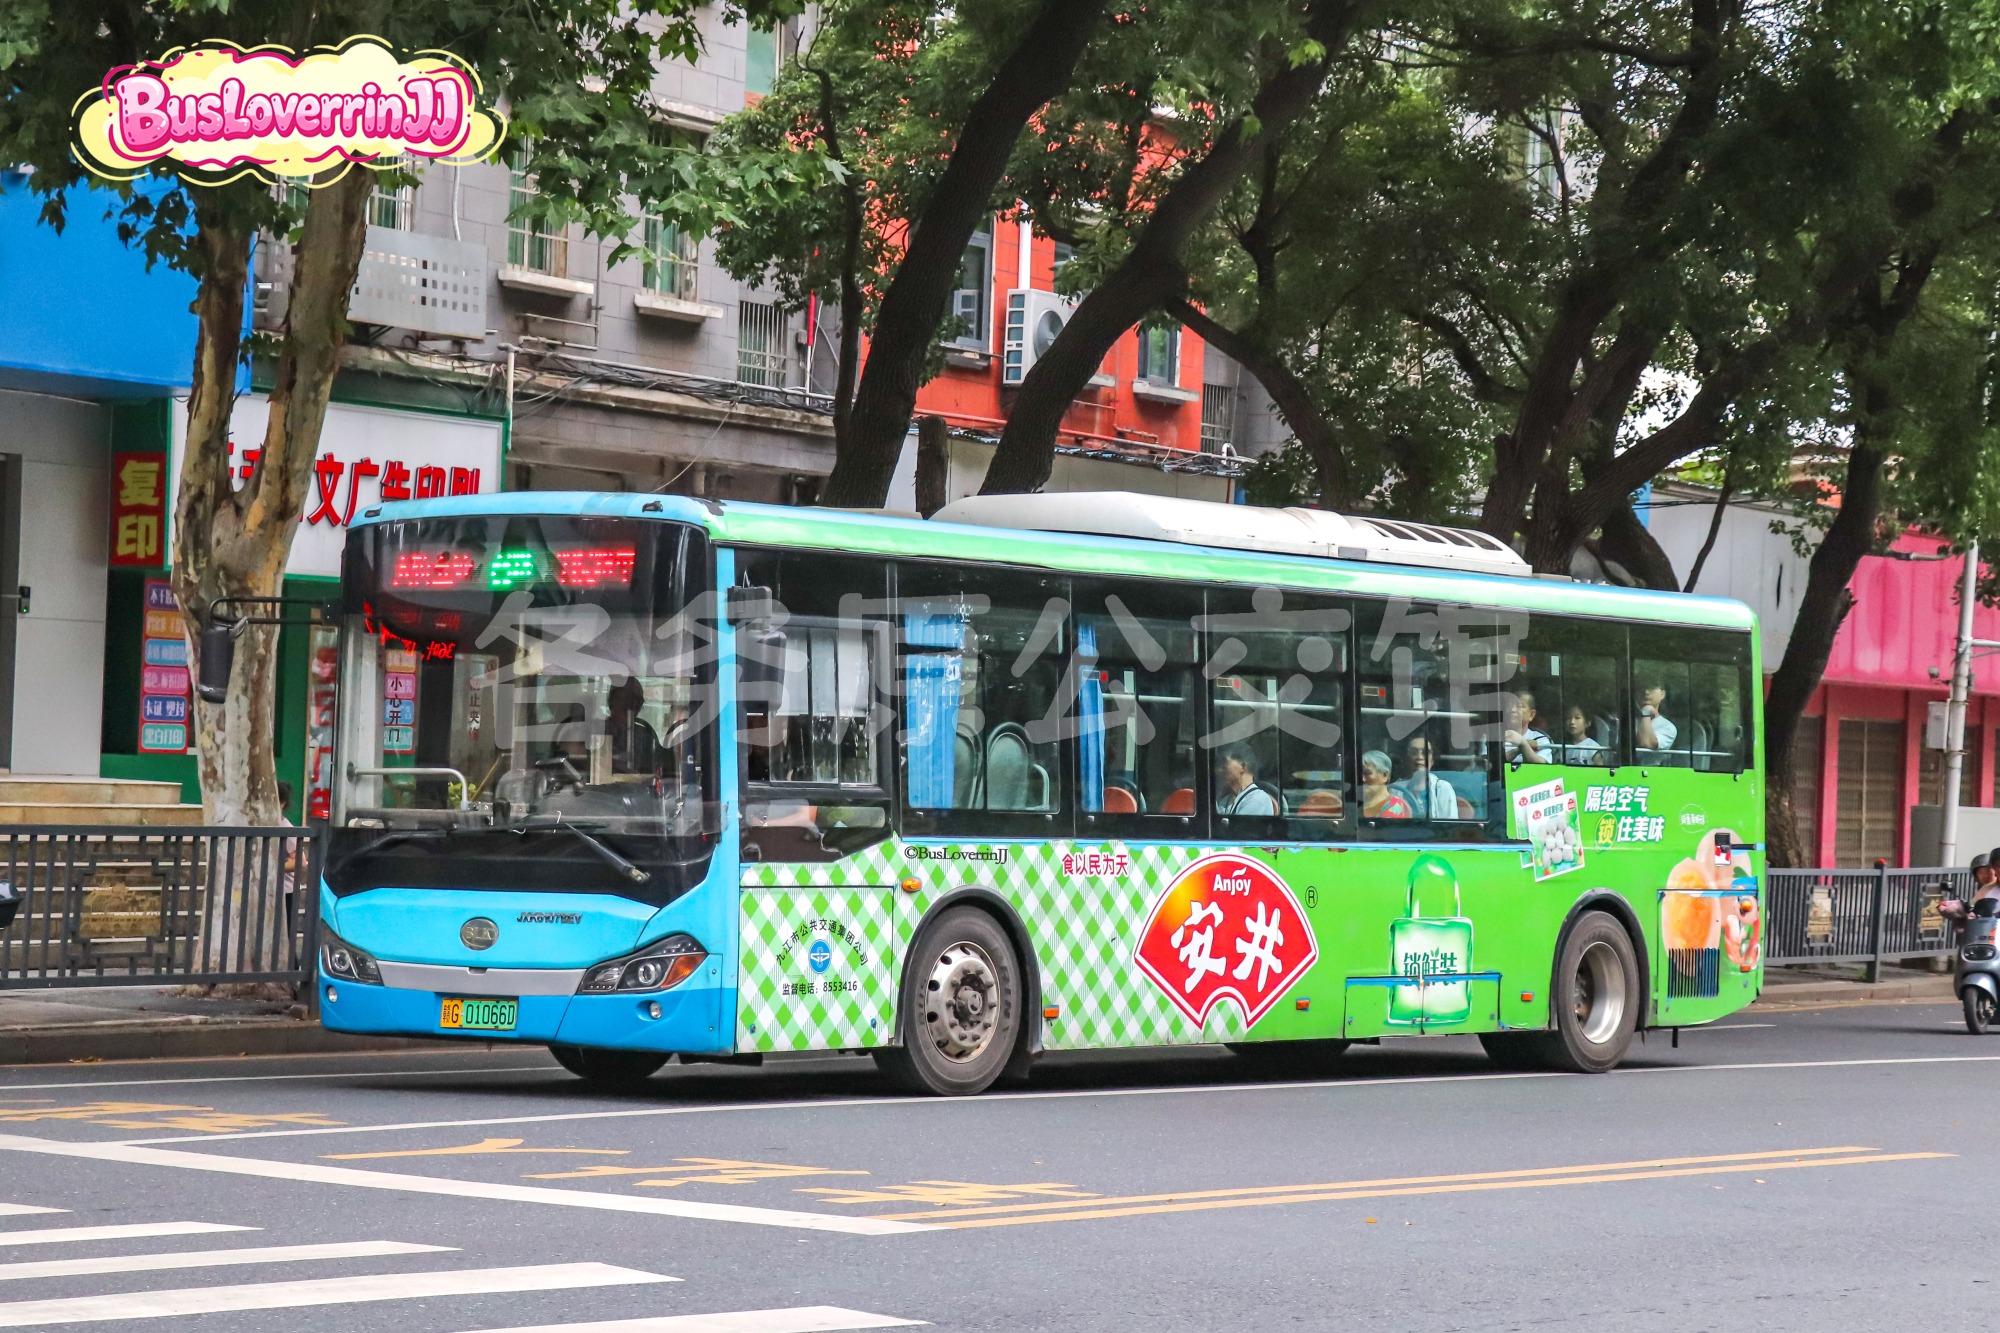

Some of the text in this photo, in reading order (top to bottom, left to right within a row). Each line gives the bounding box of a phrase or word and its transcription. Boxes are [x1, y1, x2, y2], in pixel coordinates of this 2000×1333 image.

[116, 460, 160, 559] 复印
[389, 677, 403, 742] 小心开门
[1584, 785, 1650, 812] 隔绝空气
[1062, 852, 1129, 876] 食以民为天
[1213, 867, 1252, 896] Anjoy
[776, 918, 869, 967] 九江市公共交通集团公司
[1171, 900, 1285, 995] 安井
[1403, 948, 1458, 986] 锁鲜装
